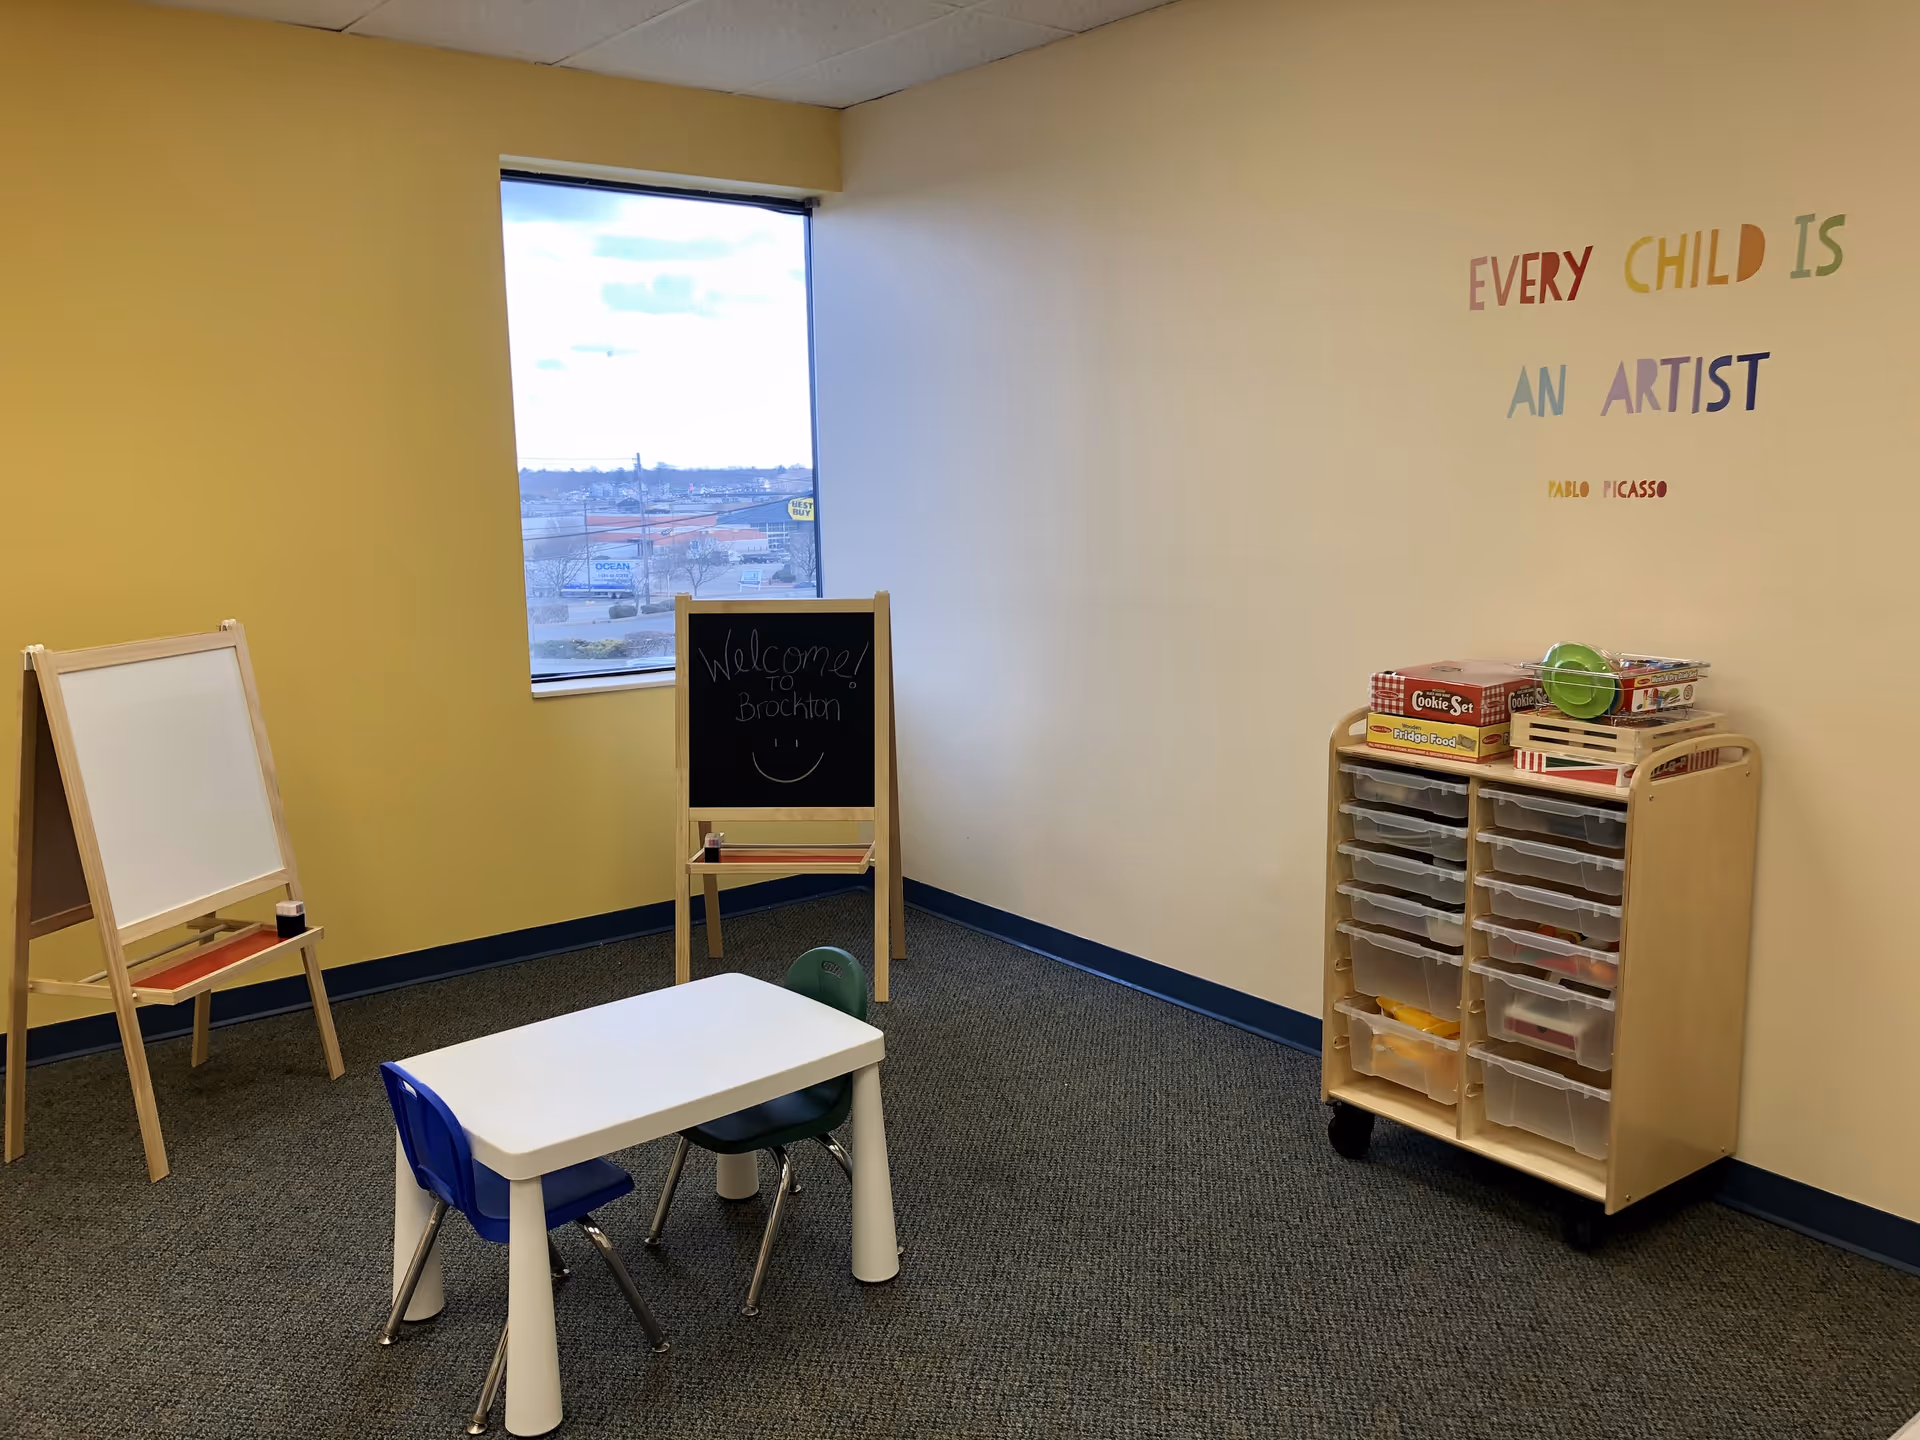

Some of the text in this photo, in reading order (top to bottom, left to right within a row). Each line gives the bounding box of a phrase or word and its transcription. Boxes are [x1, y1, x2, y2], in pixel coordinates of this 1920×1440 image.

[1468, 213, 1847, 312] EVERY CHILD IS
[1506, 351, 1771, 419] AN ARTIST
[1547, 479, 1668, 499] PABLO PICASSO
[791, 500, 814, 510] BEST
[792, 508, 811, 517] BUY
[595, 562, 631, 570] OCEAN
[698, 628, 870, 689] Welcome!
[735, 690, 841, 722] Brockton
[1411, 690, 1449, 711] Cookie
[1450, 695, 1474, 716] Set
[1393, 728, 1428, 744] Fridge
[1429, 733, 1457, 749] Food
